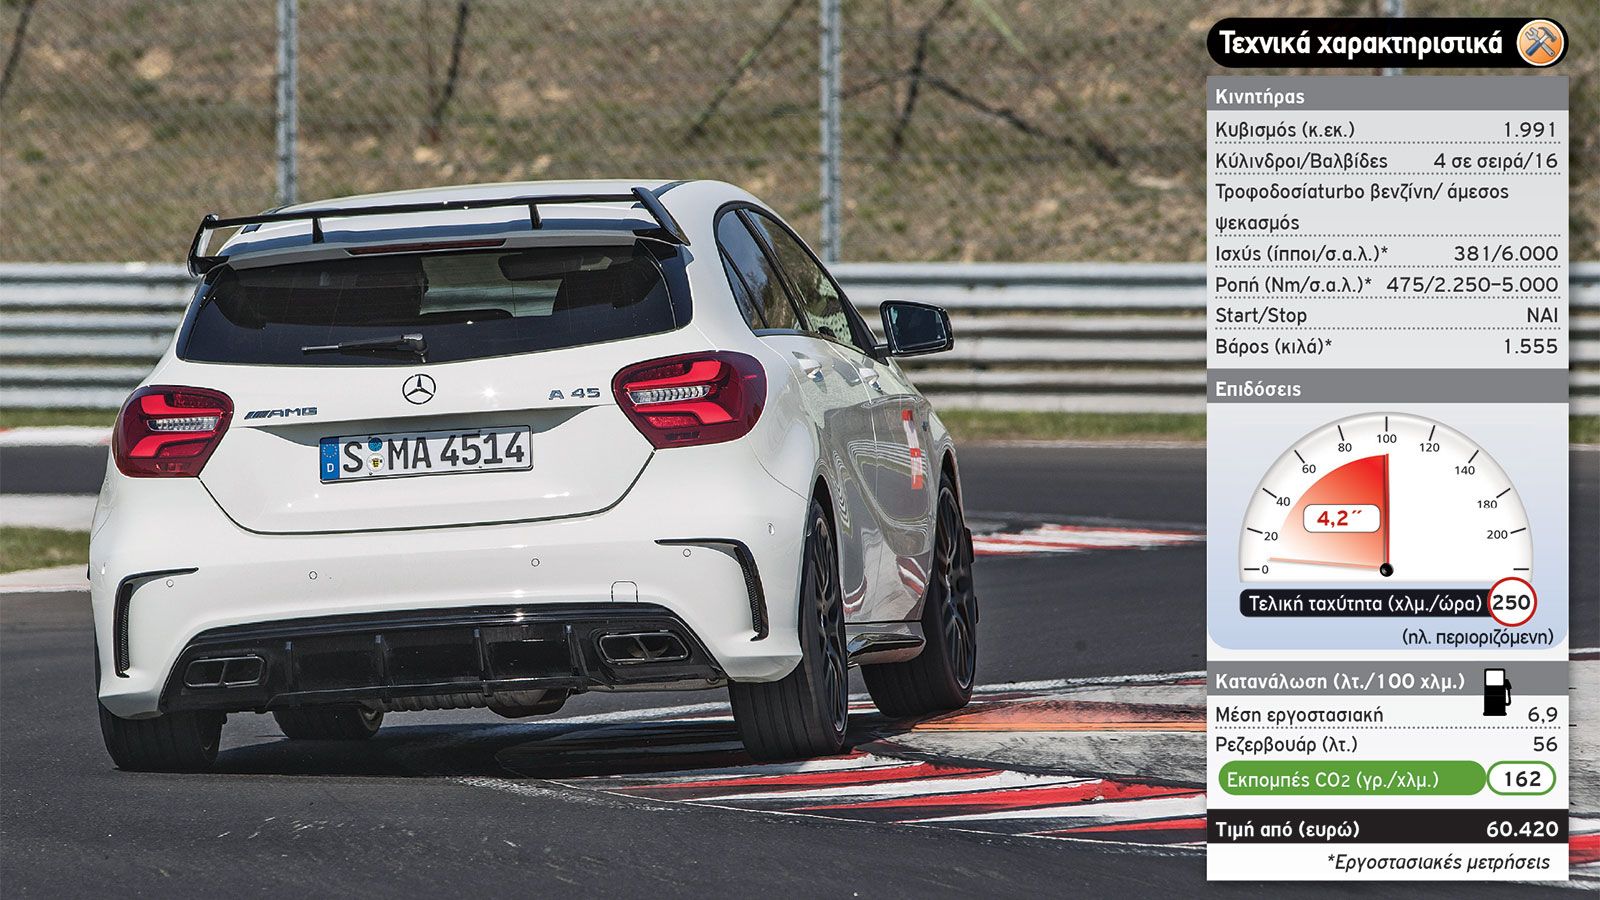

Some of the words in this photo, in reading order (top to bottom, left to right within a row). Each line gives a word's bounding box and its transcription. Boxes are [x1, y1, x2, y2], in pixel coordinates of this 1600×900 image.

[549, 390, 565, 401] A
[570, 387, 601, 399] 45
[343, 441, 362, 473] S
[388, 438, 432, 470] MA
[440, 431, 525, 466] 4514
[327, 463, 334, 473] D
